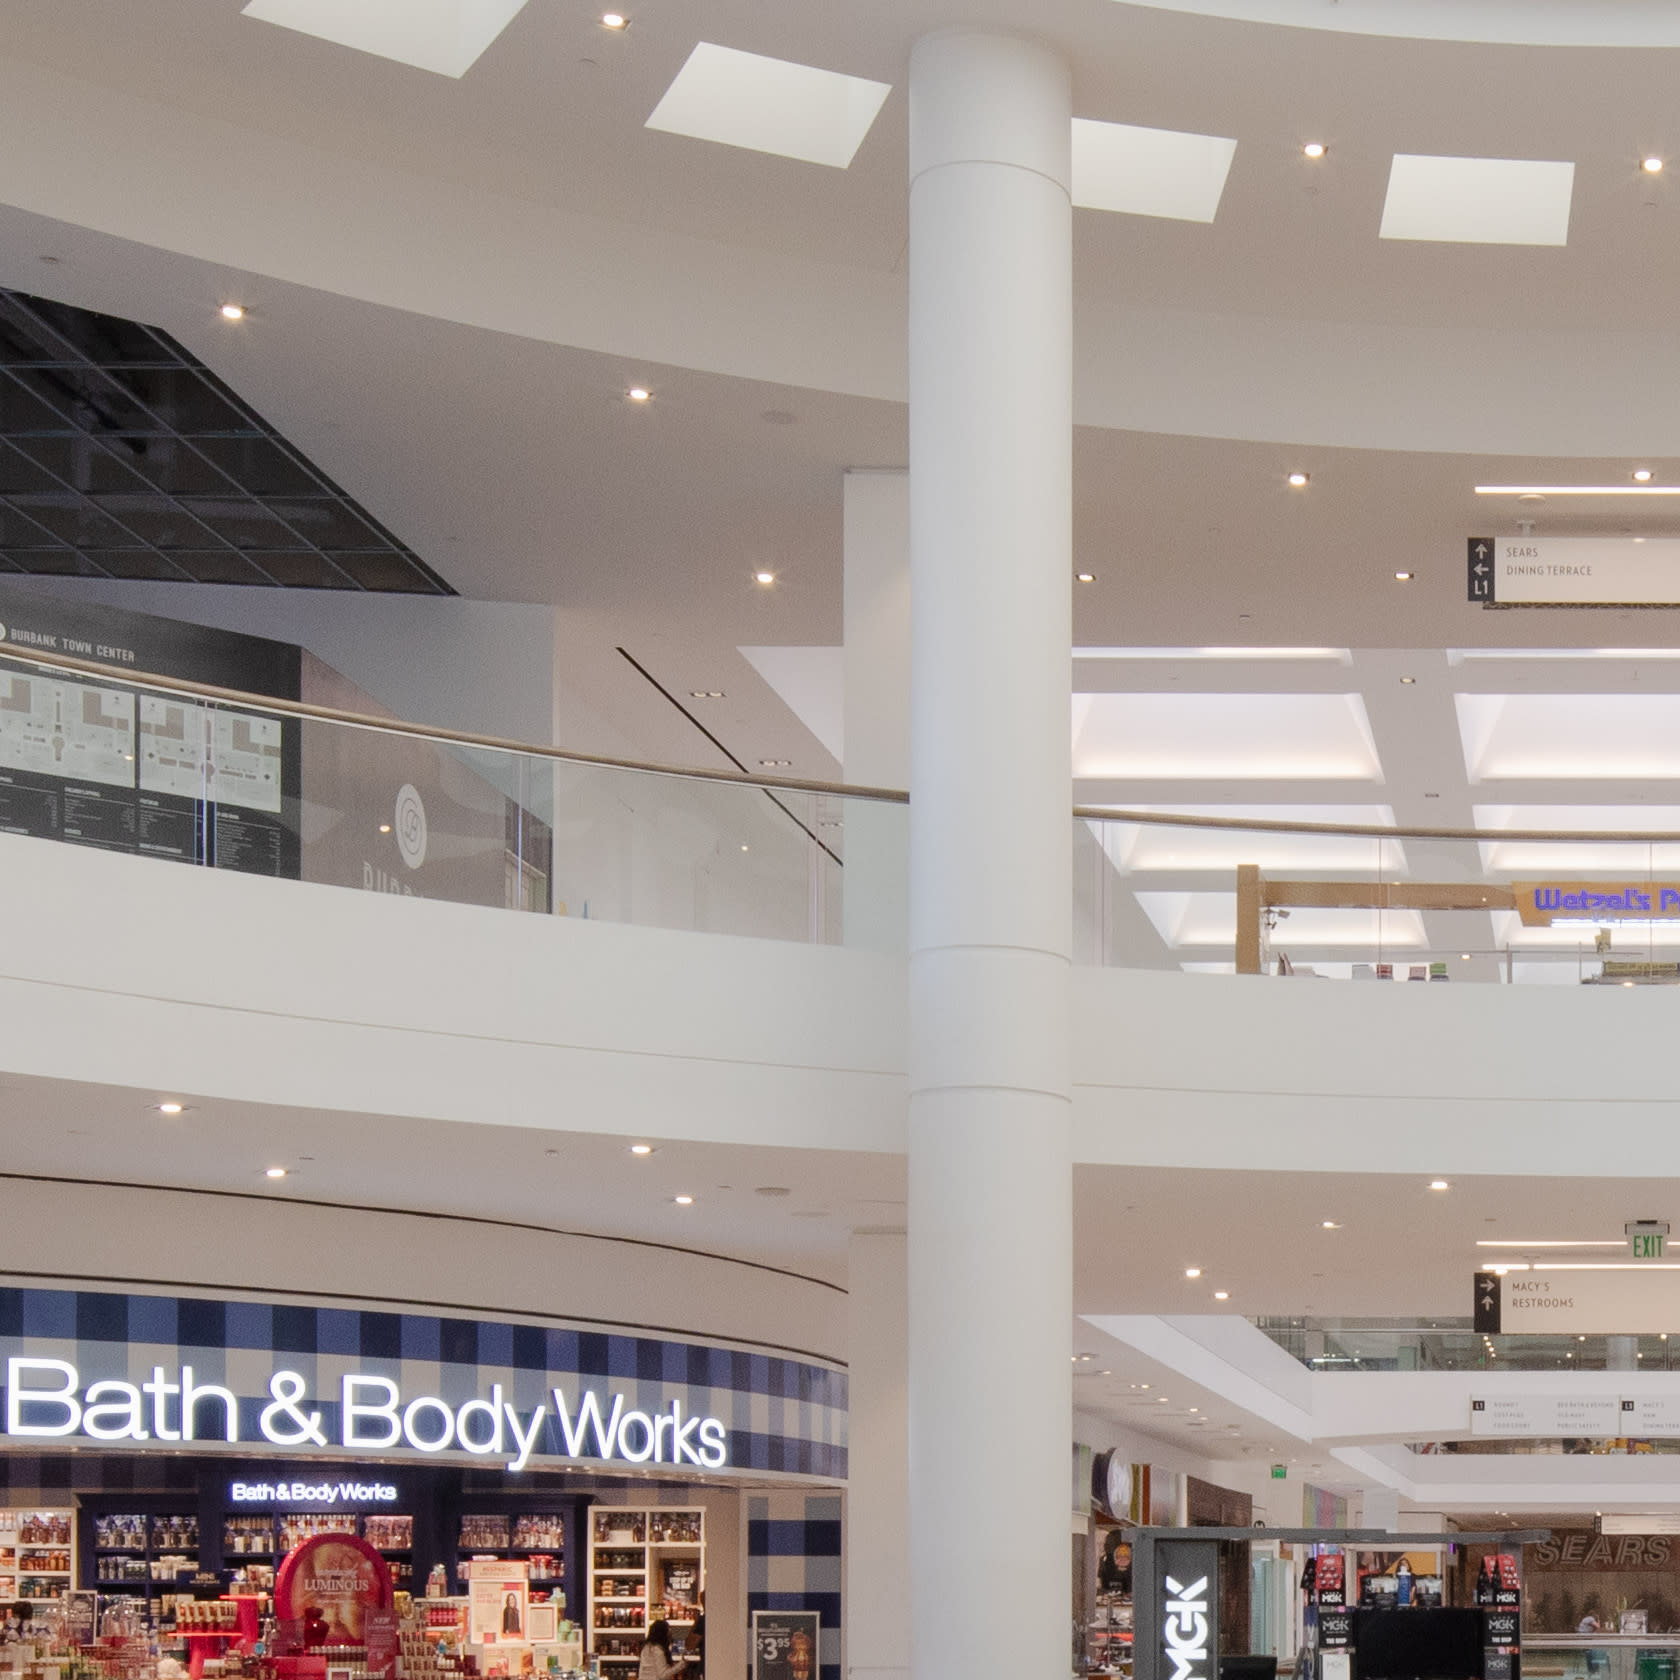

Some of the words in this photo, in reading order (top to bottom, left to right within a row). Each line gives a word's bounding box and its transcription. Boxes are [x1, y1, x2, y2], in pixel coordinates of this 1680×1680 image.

[1506, 547, 1538, 558] SEARS
[1506, 566, 1544, 577] DINING
[1545, 566, 1592, 577] TERRACE
[1474, 580, 1488, 595] L1
[10, 628, 57, 648] BURBANK
[62, 638, 93, 655] TOWN
[96, 645, 136, 663] CENTER
[1534, 888, 1652, 910] Wetzel's
[1633, 1235, 1663, 1258] EXIT
[1512, 1282, 1550, 1292] MACY'S
[1512, 1298, 1574, 1308] RESTROOMS
[5, 1357, 237, 1441] Bath
[259, 1370, 328, 1447] &
[342, 1375, 546, 1472] Body
[552, 1388, 726, 1469] Works
[231, 1483, 275, 1501] Bath
[275, 1484, 290, 1501] &
[290, 1483, 339, 1504] Body
[339, 1483, 397, 1501] Works
[1535, 1535, 1671, 1565] SEARS
[303, 1579, 369, 1592] LUMINOUS
[1322, 1619, 1350, 1632] MGK
[1488, 1619, 1515, 1631] MGK
